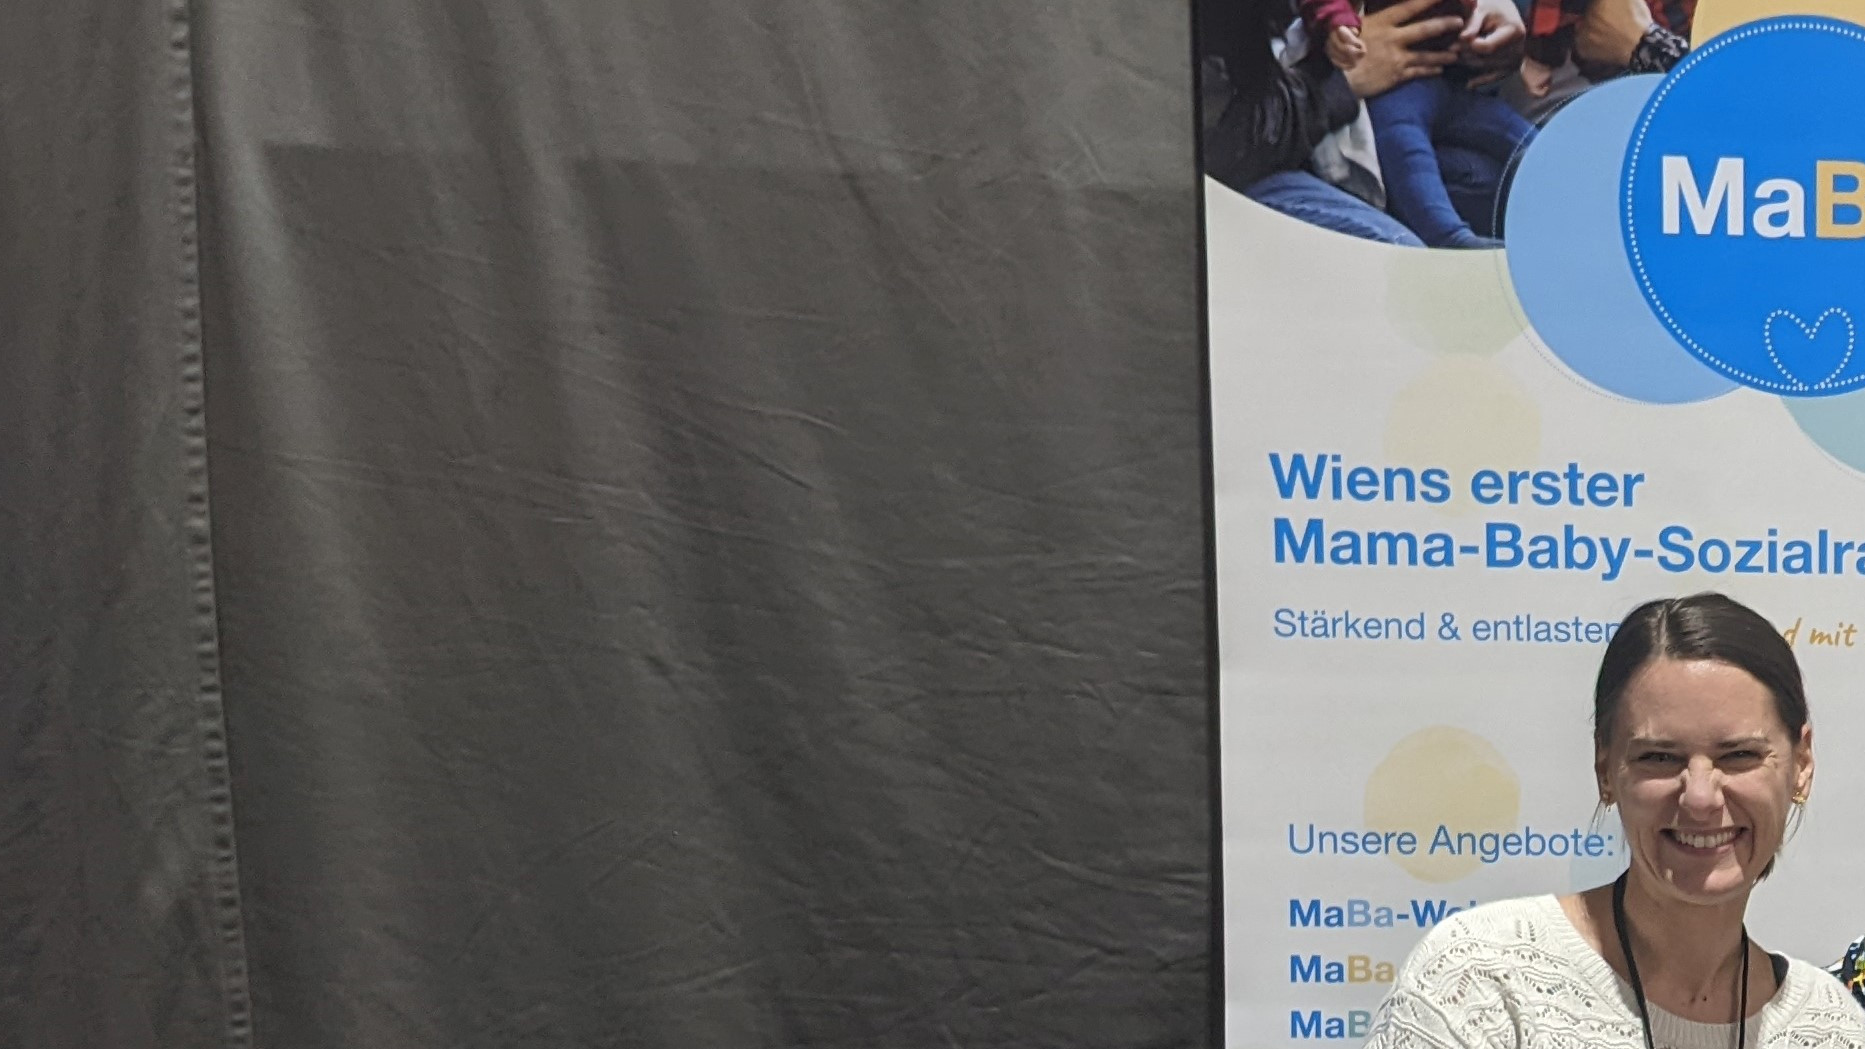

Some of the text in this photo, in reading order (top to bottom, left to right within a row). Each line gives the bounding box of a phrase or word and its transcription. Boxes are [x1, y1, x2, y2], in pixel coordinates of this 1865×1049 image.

[1269, 452, 1645, 507] Wiens erster
[1274, 608, 1425, 640] Stärkend
[1437, 612, 1461, 641] &
[1809, 622, 1858, 648] mit
[1289, 824, 1615, 863] Unsere Angebote:
